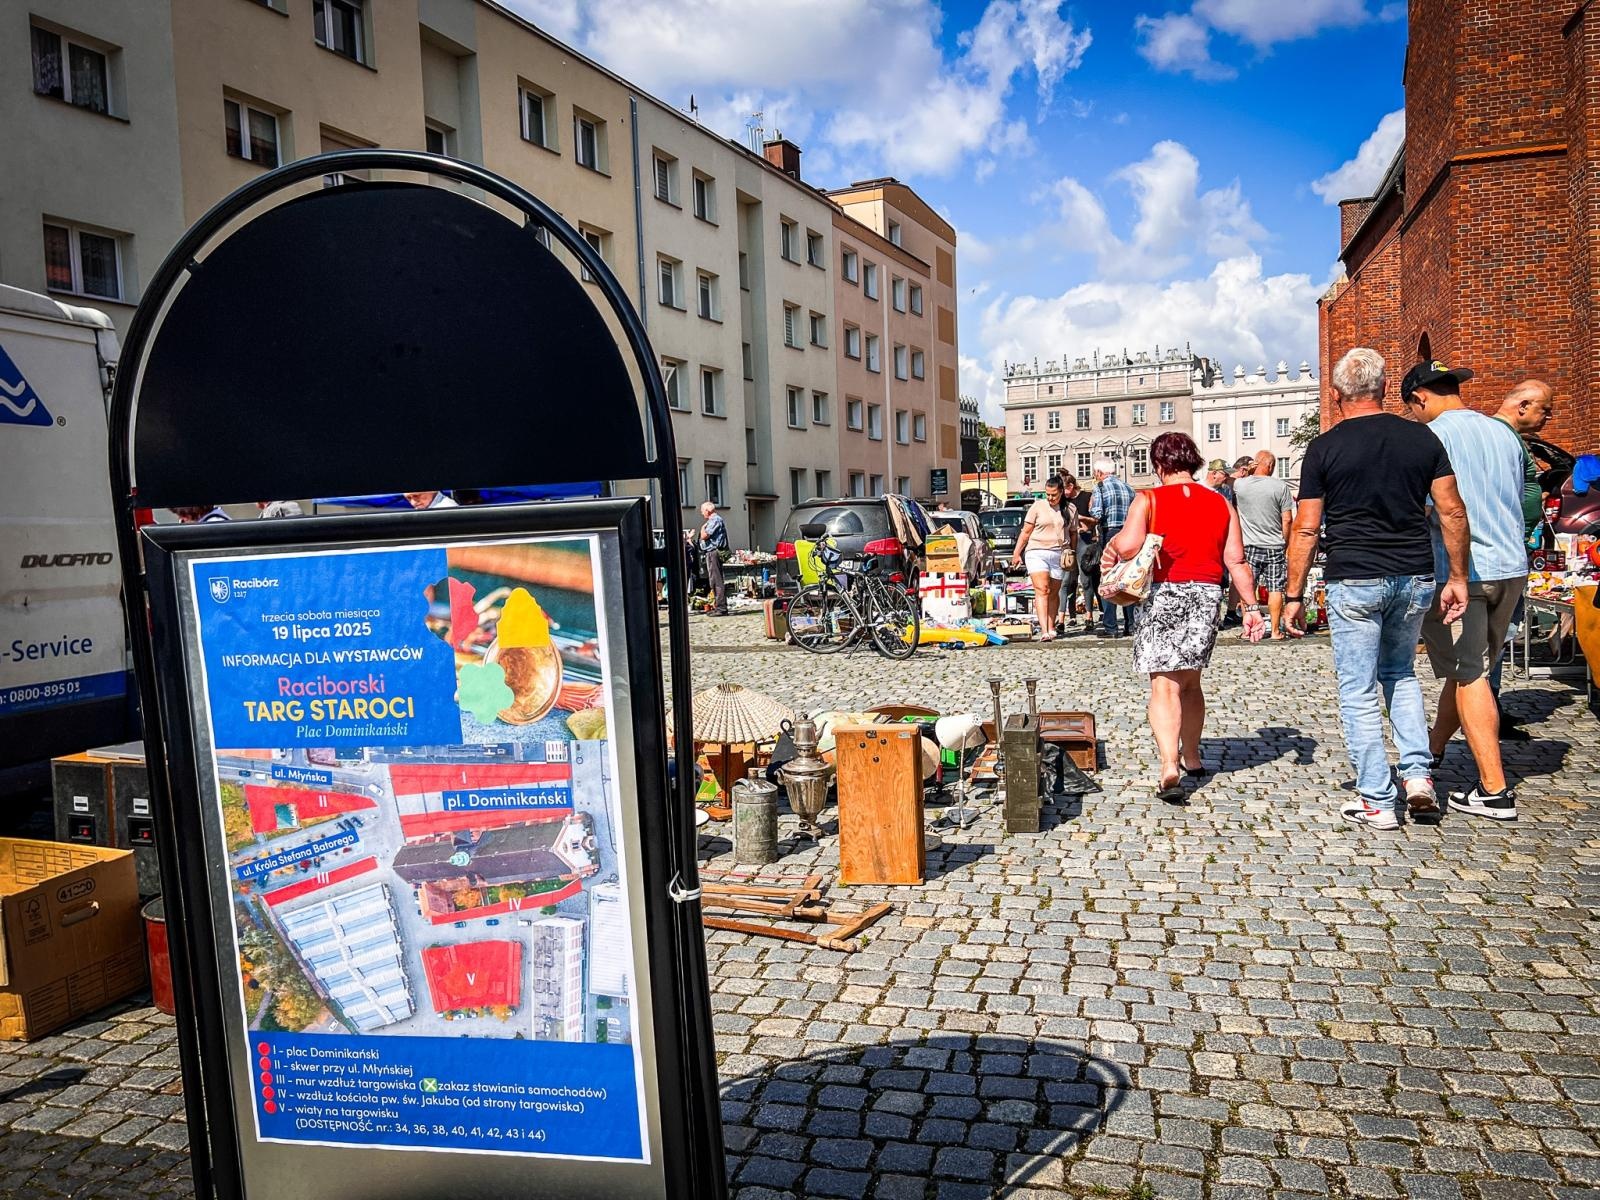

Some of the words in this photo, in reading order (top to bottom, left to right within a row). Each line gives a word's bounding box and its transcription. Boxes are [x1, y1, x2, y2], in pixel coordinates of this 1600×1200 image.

[20, 552, 113, 569] DUCATO
[233, 577, 279, 589] Racibórz
[261, 612, 295, 622] trzecia
[298, 611, 332, 621] sobota
[335, 609, 380, 620] miesiąca
[272, 626, 288, 640] 19
[293, 624, 331, 642] lipca
[334, 622, 372, 637] 2025
[0, 634, 93, 663] -Service
[222, 652, 302, 668] INFORMACJA
[305, 651, 331, 664] DLA
[332, 644, 424, 663] WYSTAWCÓW
[278, 674, 385, 697] Raciborski
[243, 700, 304, 722] TARG
[310, 697, 415, 721] STAROCI
[295, 725, 322, 738] Plac
[325, 722, 408, 737] Dominikański
[274, 770, 287, 779] ul.
[288, 770, 327, 783] Młyńska
[319, 795, 328, 808] II
[447, 795, 465, 810] pl.
[469, 789, 567, 808] Dominikański
[242, 866, 255, 877] ul.
[254, 858, 278, 874] Króla
[277, 848, 313, 865] Stefana
[312, 834, 355, 855] Batorego
[317, 872, 330, 884] III
[509, 898, 521, 911] IV
[466, 973, 475, 986] V
[286, 1046, 308, 1059] plac
[310, 1047, 379, 1060] Dominikański
[274, 1060, 281, 1070] II
[290, 1062, 320, 1072] skwer
[322, 1064, 345, 1075] przy
[348, 1063, 360, 1074] ul.
[363, 1063, 413, 1078] Młyńskiej
[276, 1074, 285, 1084] III
[295, 1078, 315, 1086] mur
[318, 1077, 355, 1088] wzdłuż
[358, 1078, 416, 1091] targowiska
[472, 1083, 525, 1094] stawiania
[528, 1085, 607, 1100] samochodów)
[277, 1089, 287, 1099] IV
[297, 1091, 333, 1101] wzdłuż
[336, 1091, 378, 1103] kościoła
[381, 1095, 400, 1105] pw.
[402, 1093, 419, 1105] św.
[421, 1095, 460, 1107] Jakuba
[462, 1096, 481, 1108] (od
[483, 1098, 516, 1111] strony
[519, 1101, 585, 1113] targowiska)
[279, 1103, 285, 1112] V
[295, 1105, 323, 1117] wiaty
[325, 1107, 338, 1116] na
[341, 1106, 399, 1119] targowisku
[295, 1118, 374, 1132] (DOSTĘPNOŚĆ
[376, 1123, 392, 1132] nr.:
[395, 1124, 411, 1135] 34,
[413, 1124, 430, 1135] 36,
[432, 1125, 449, 1136] 38,
[451, 1126, 468, 1137] 40,
[470, 1126, 484, 1138] 41,
[486, 1127, 503, 1139] 42,
[505, 1128, 519, 1139] 43
[527, 1129, 546, 1141] 44)
